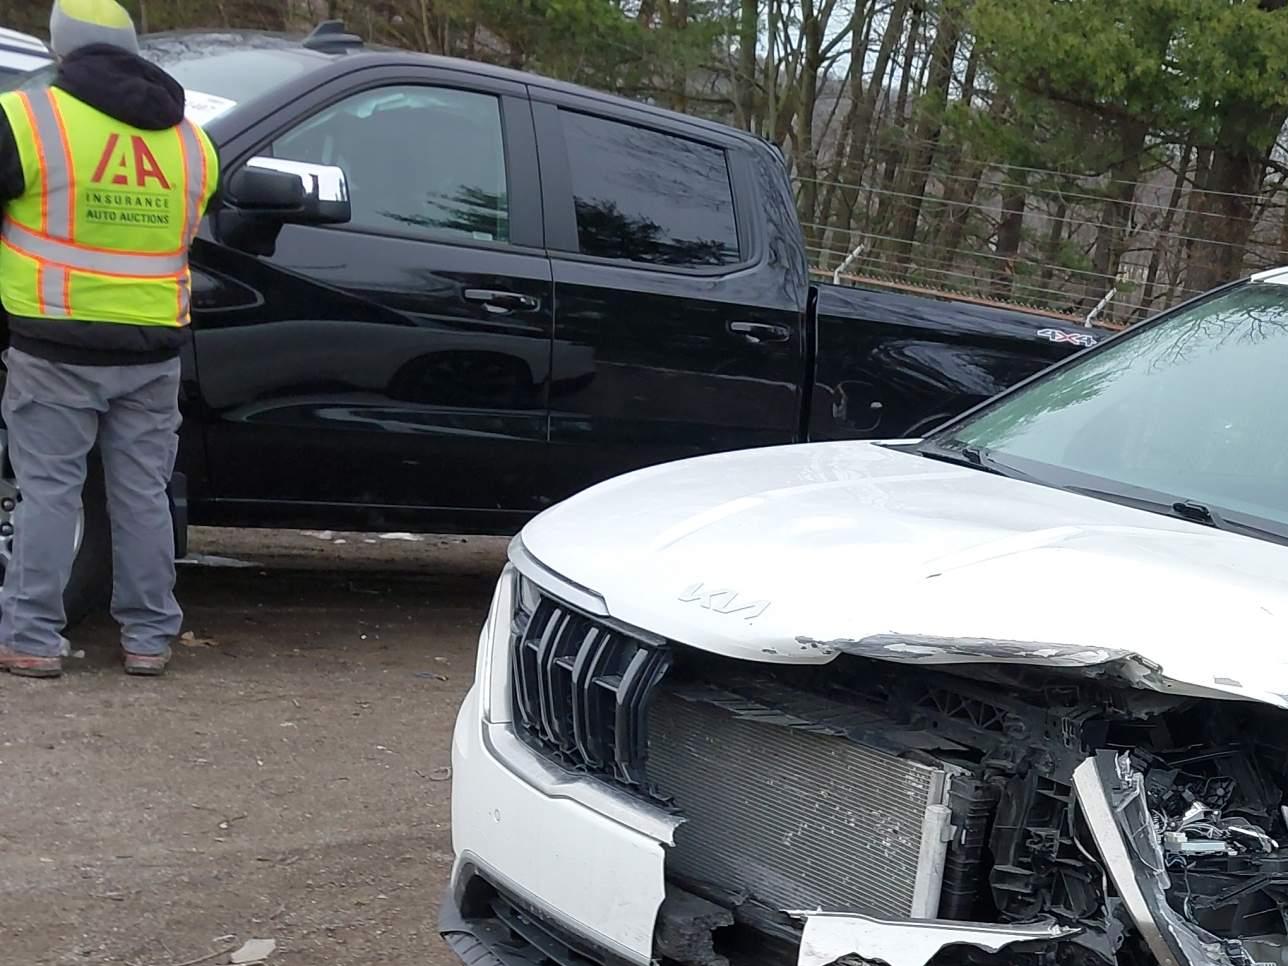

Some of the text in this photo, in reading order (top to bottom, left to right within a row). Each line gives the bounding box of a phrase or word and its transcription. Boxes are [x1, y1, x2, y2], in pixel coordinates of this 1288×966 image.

[86, 192, 169, 208] INSURANCE
[86, 209, 169, 224] AUTO AUCTIONS
